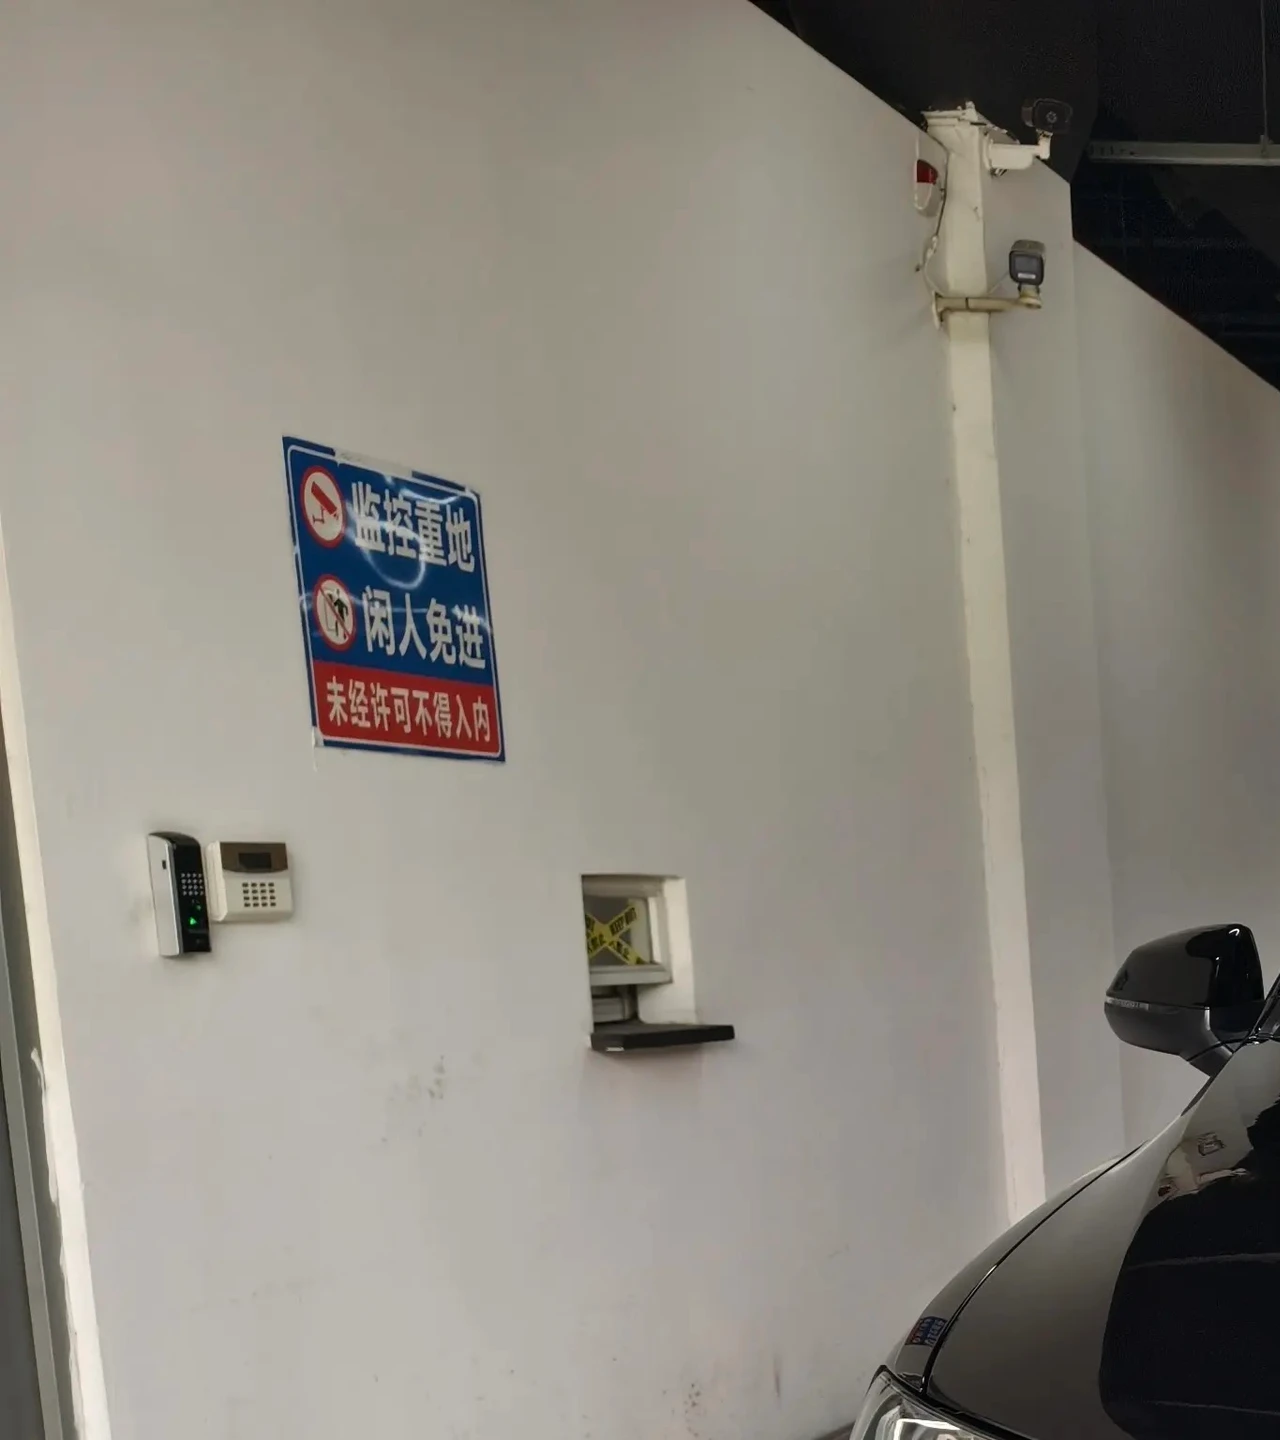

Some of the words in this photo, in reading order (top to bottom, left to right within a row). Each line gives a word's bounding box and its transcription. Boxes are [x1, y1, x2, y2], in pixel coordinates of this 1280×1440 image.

[351, 481, 475, 573] 监控重地
[361, 585, 487, 670] 闲人免进
[326, 676, 491, 742] 未经许可不得入内
